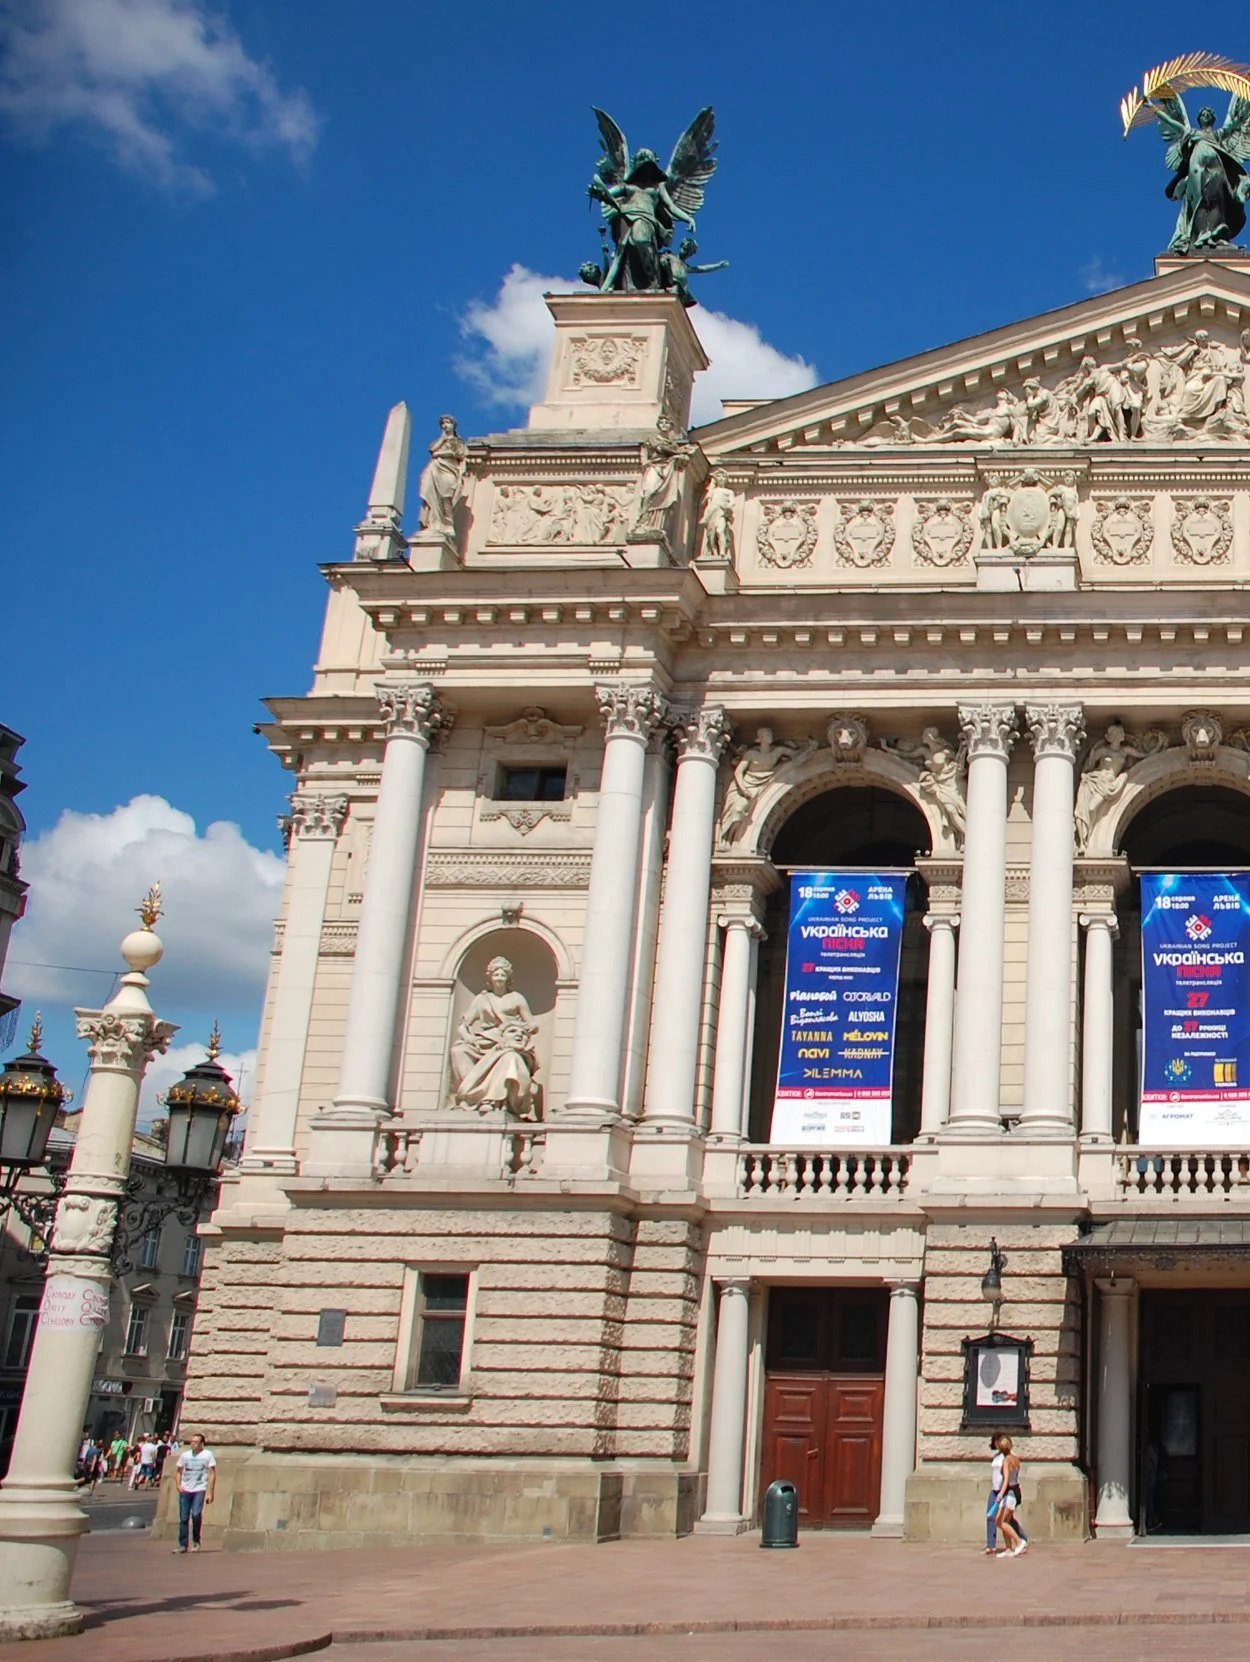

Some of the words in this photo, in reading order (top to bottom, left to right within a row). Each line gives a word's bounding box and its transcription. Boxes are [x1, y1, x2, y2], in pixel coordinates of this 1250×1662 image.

[798, 886, 813, 898] 18
[1155, 896, 1172, 909] 18
[1213, 902, 1240, 910] ЛЬВІВ
[1187, 992, 1209, 1008] 27
[848, 1011, 884, 1022] ALYOSHA
[1183, 1021, 1198, 1032] 27
[792, 1030, 832, 1042] TAYANNA
